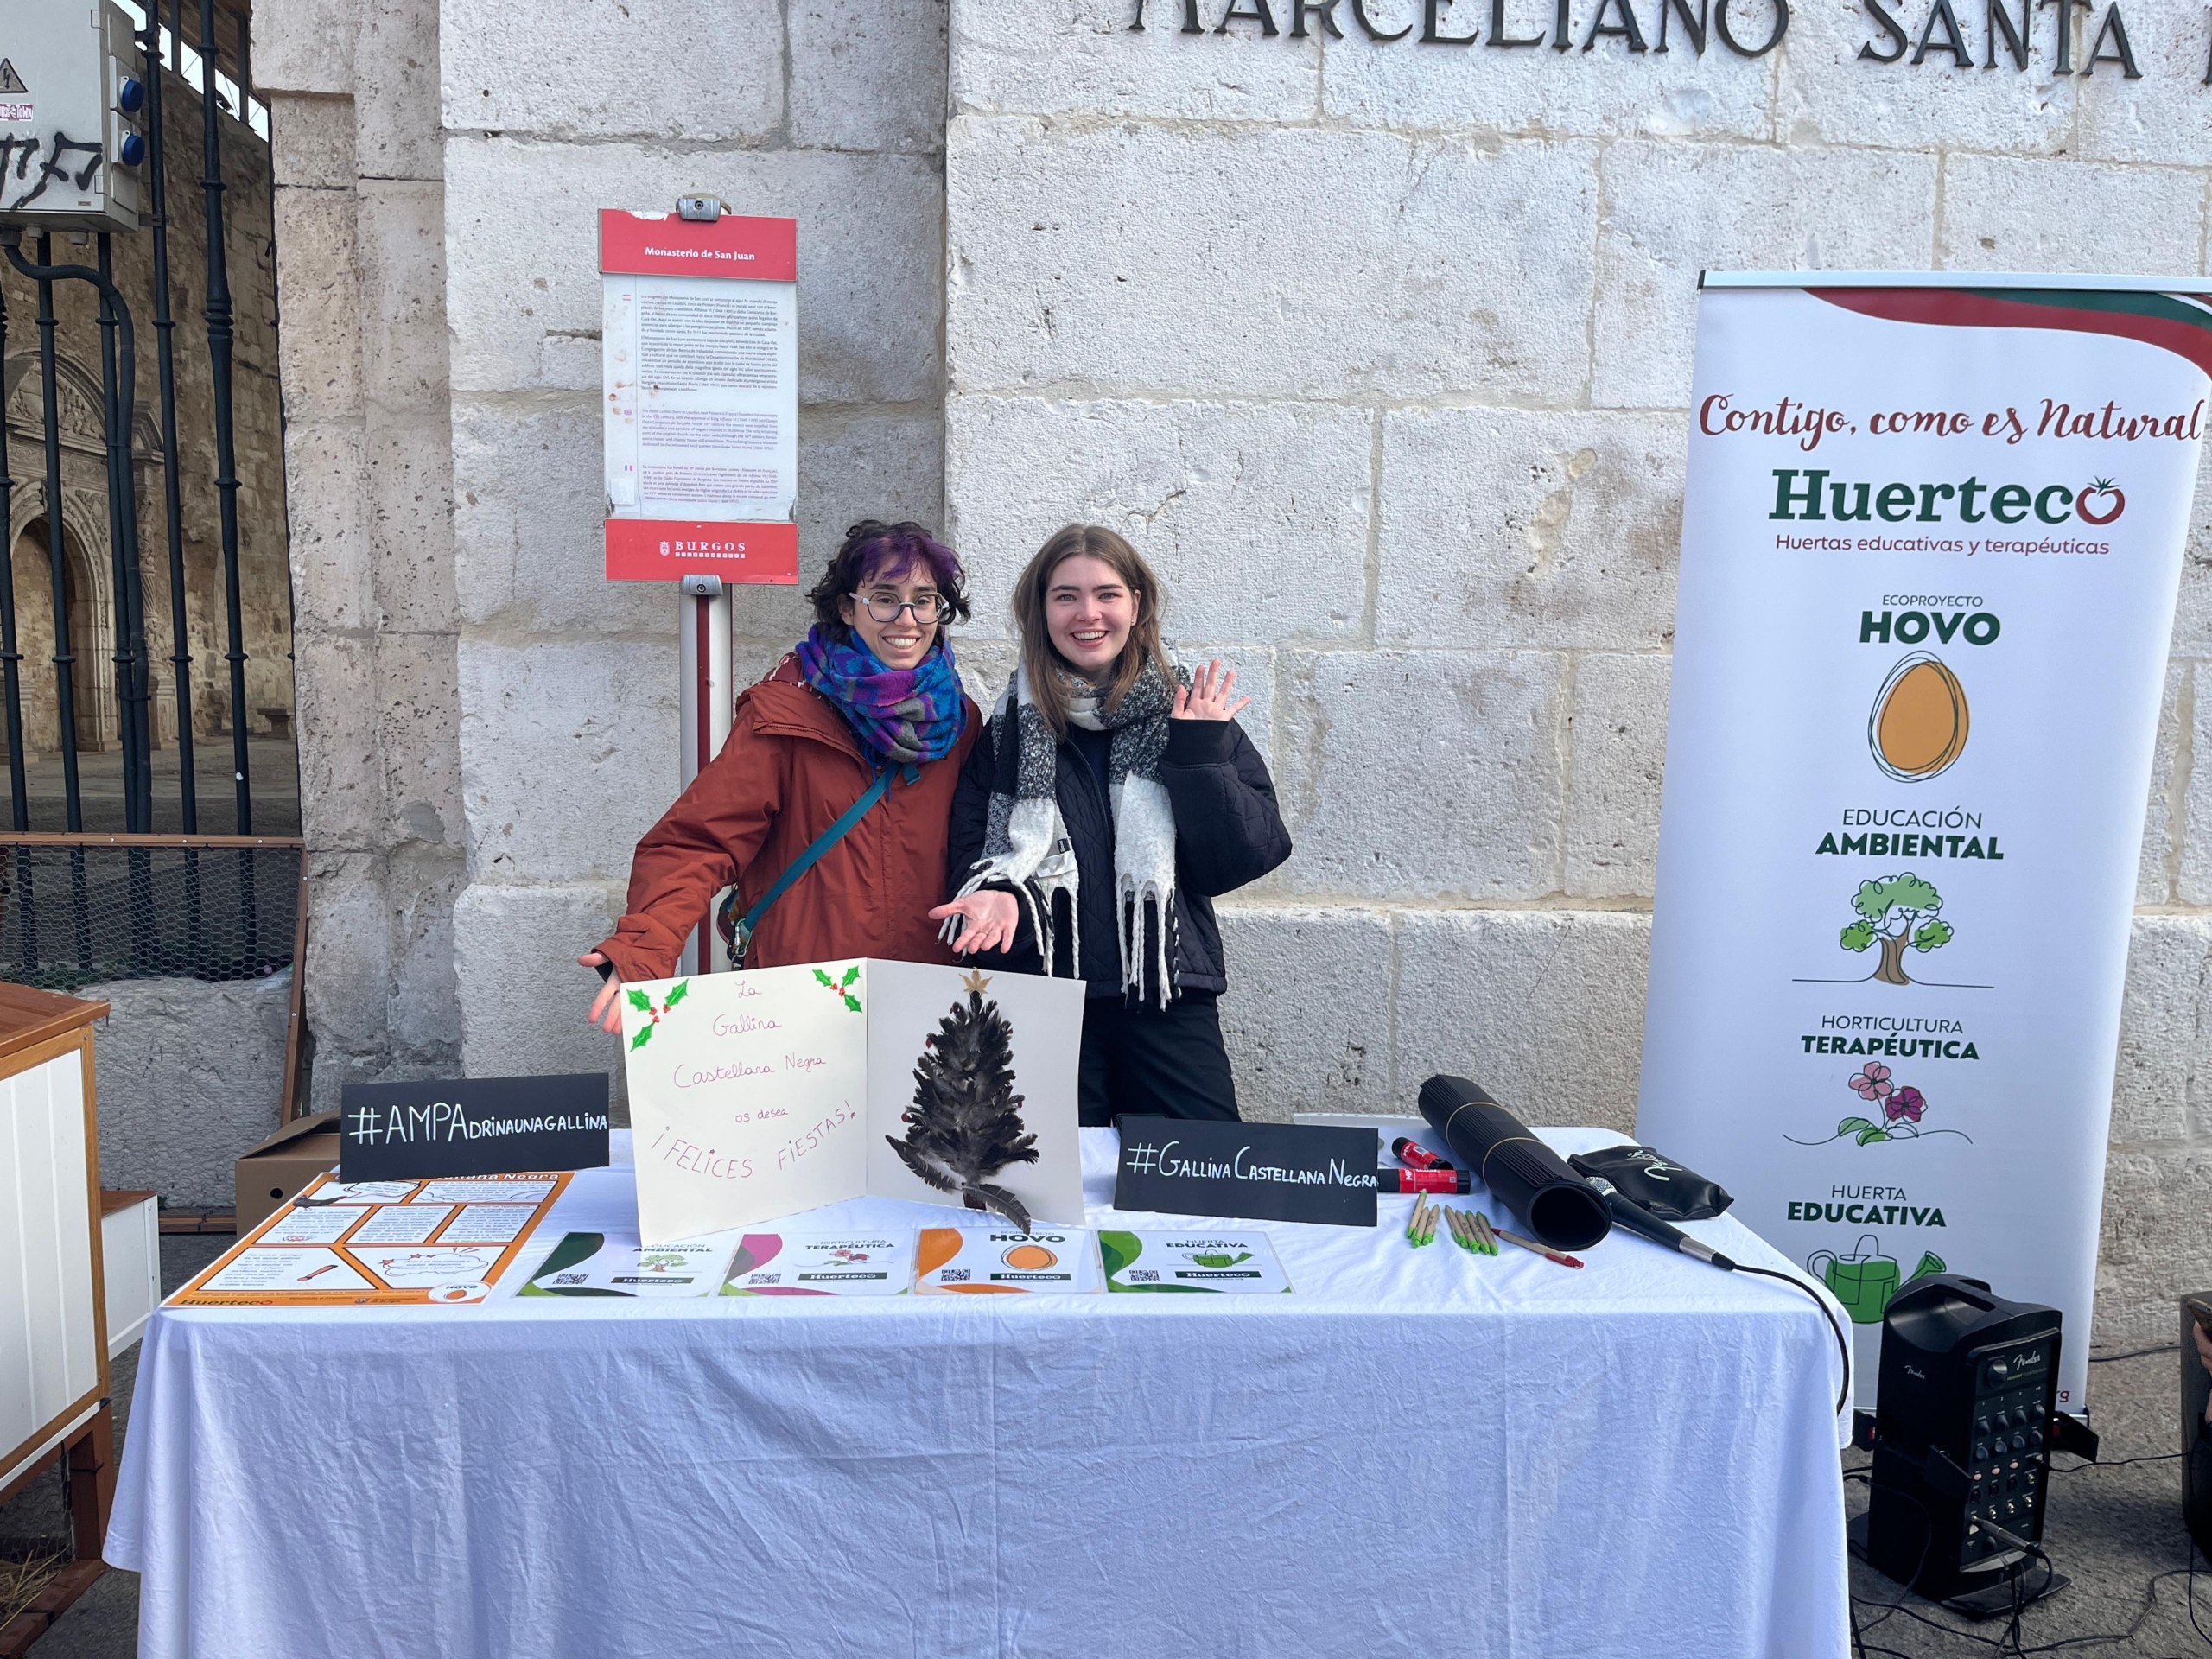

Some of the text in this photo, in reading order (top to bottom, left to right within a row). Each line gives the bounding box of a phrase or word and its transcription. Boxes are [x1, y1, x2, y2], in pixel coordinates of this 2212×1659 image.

[1858, 0, 2143, 79] SANTA
[645, 247, 755, 261] Monasterio de San Juan
[1700, 393, 2205, 452] Contigo, como es Natural
[1768, 468, 2126, 525] Huerteco
[675, 541, 746, 552] BURGOS
[1776, 534, 2110, 557] Huertas educativas y terapéuticas
[1882, 594, 1984, 607] ECOPROYECTO
[1859, 610, 2001, 645] HOVO
[1842, 806, 1983, 830] EDUCACIÓN
[1815, 832, 2005, 860] AMBIENTAL
[735, 980, 763, 999] La
[713, 1014, 782, 1037] Gallina
[1821, 1015, 1964, 1034] HORTICULTURA
[1801, 1033, 1980, 1060] TERAPÉUTICA
[673, 1052, 827, 1089] Castellana Negra
[757, 1108, 789, 1121] desea
[1831, 1185, 1907, 1201] HUERTA
[1787, 1202, 1947, 1228] EDUCATIVA
[990, 1234, 1066, 1243] HOVO
[2013, 1350, 2041, 1371] Fender
